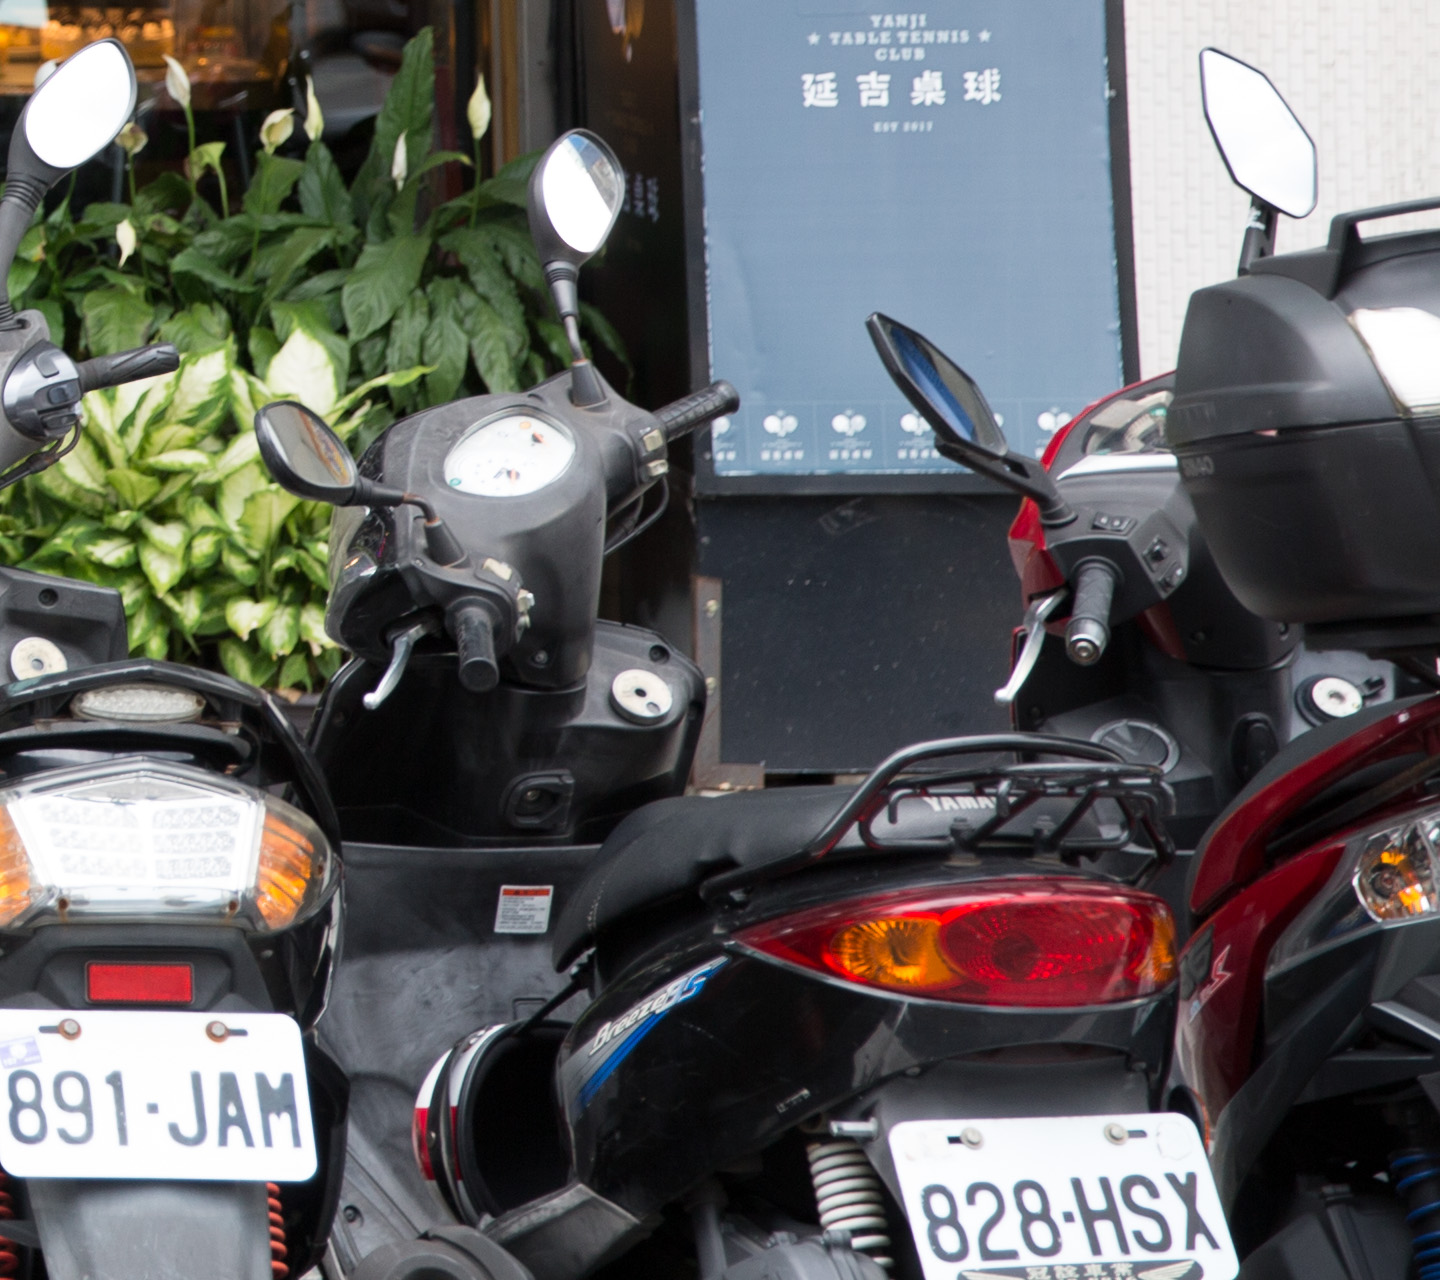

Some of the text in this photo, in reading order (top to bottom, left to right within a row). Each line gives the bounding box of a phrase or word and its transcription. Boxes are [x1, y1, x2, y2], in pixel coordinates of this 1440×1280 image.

[870, 13, 928, 30] YANJI
[828, 28, 971, 46] TABLE TENNIS
[873, 47, 927, 62] CLUB
[800, 67, 1003, 108] 延吉桌球
[873, 120, 899, 133] EST
